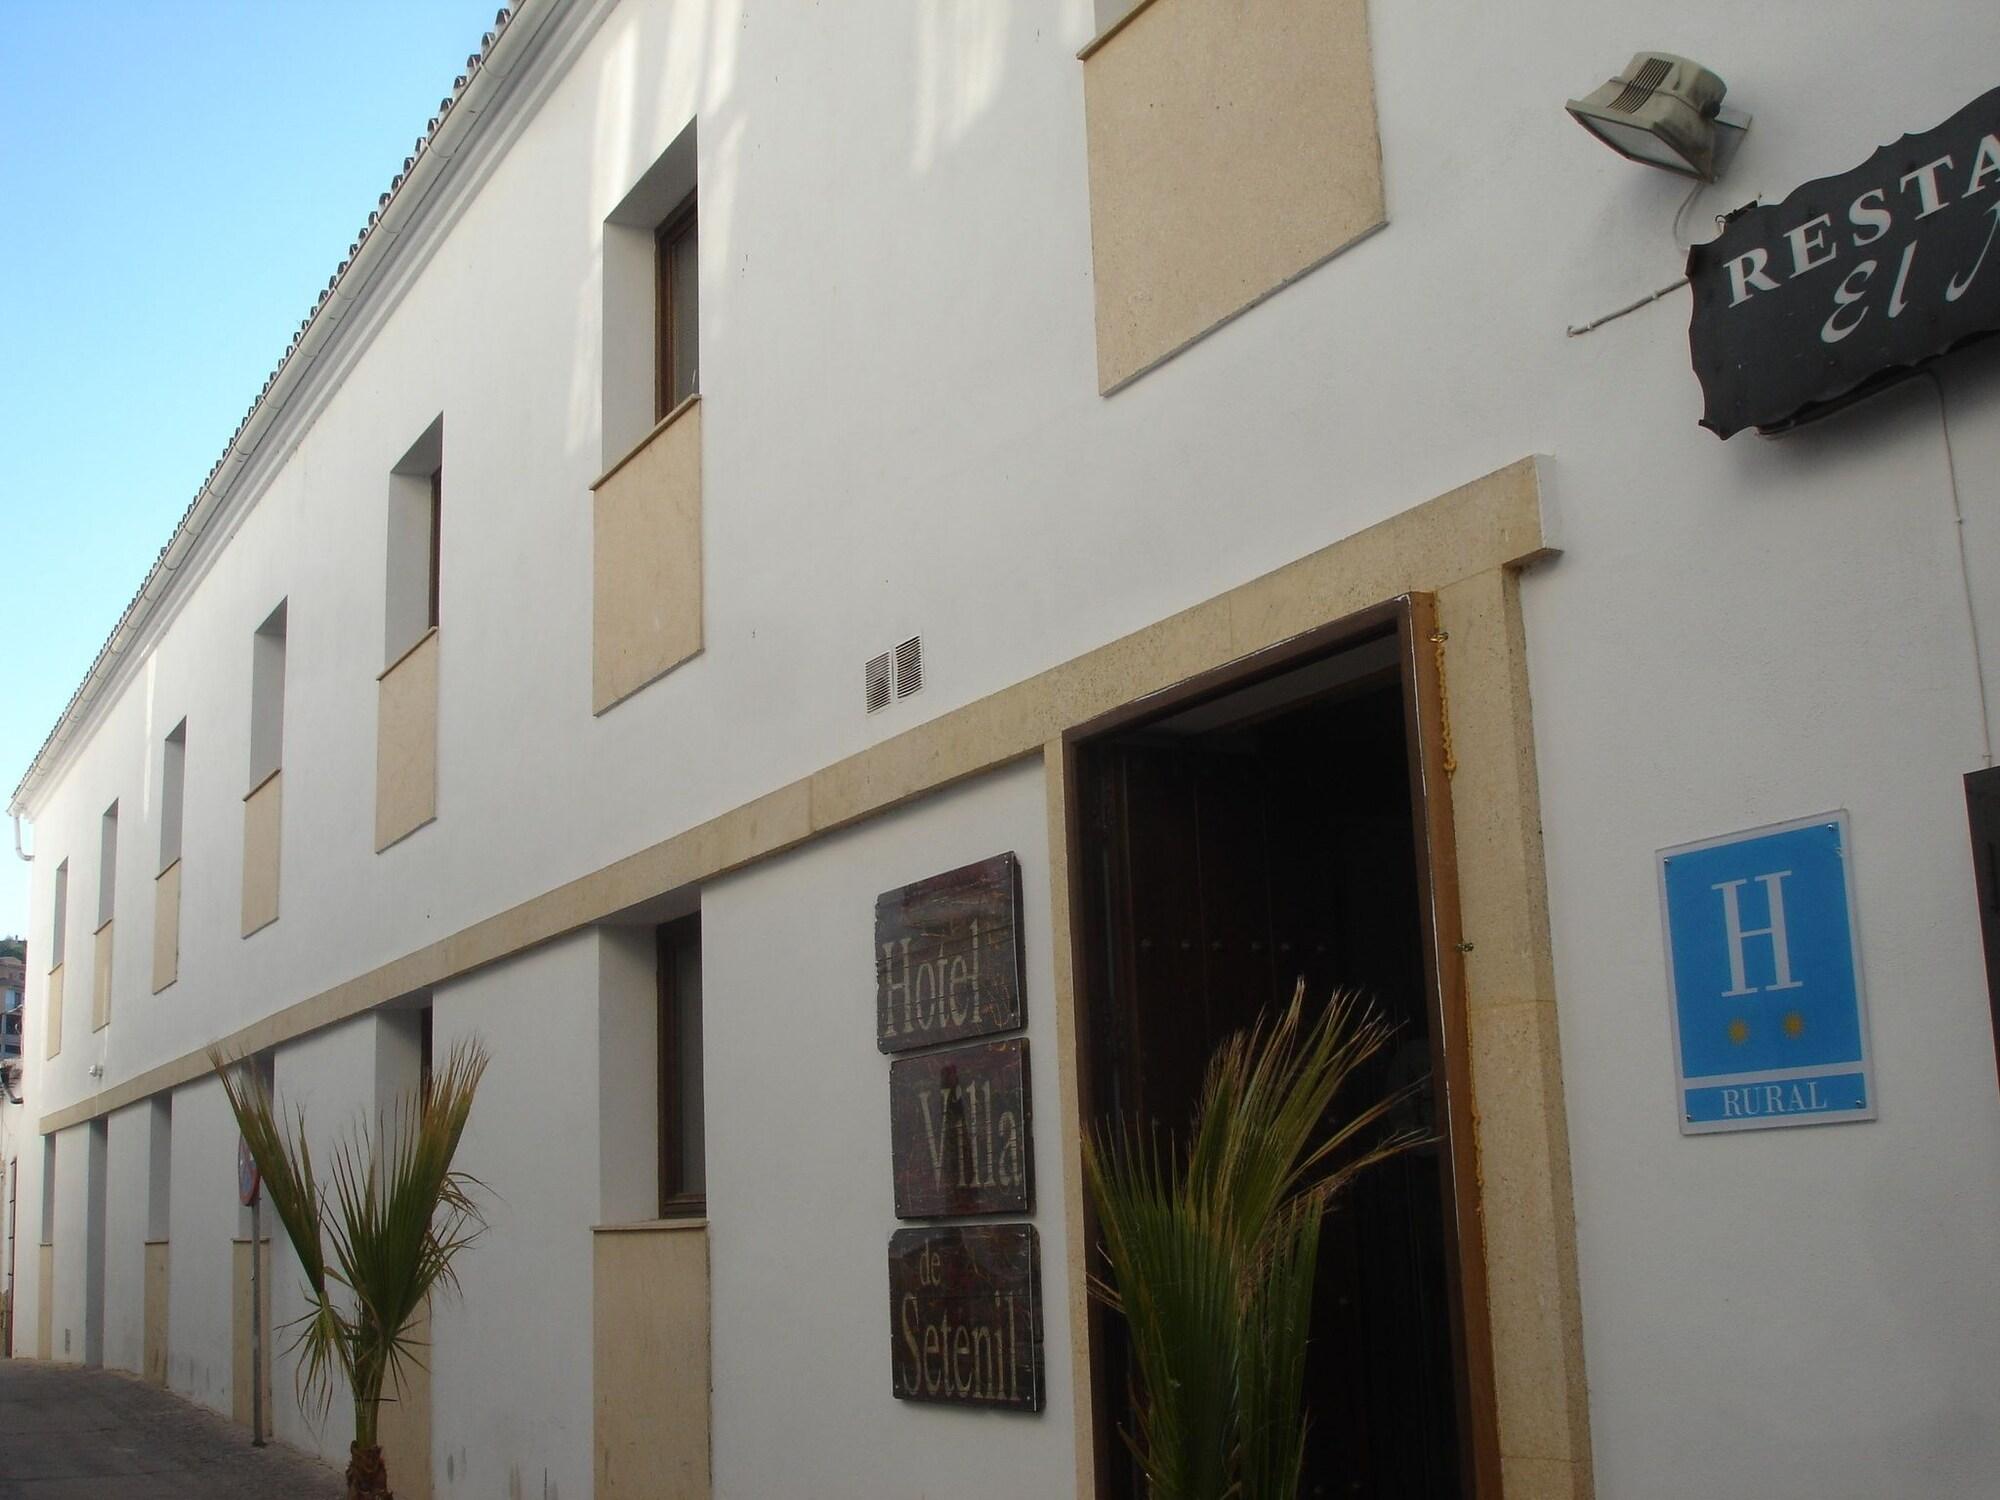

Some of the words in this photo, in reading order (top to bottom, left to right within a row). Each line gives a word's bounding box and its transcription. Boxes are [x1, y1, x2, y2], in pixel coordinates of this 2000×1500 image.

[1821, 240, 1918, 343] El
[882, 919, 983, 1036] Hotel
[1711, 870, 1804, 997] H
[919, 1079, 1022, 1191] Villa
[1720, 1081, 1827, 1117] RURAL
[919, 1237, 942, 1286] de
[901, 1289, 1021, 1401] Setenil
